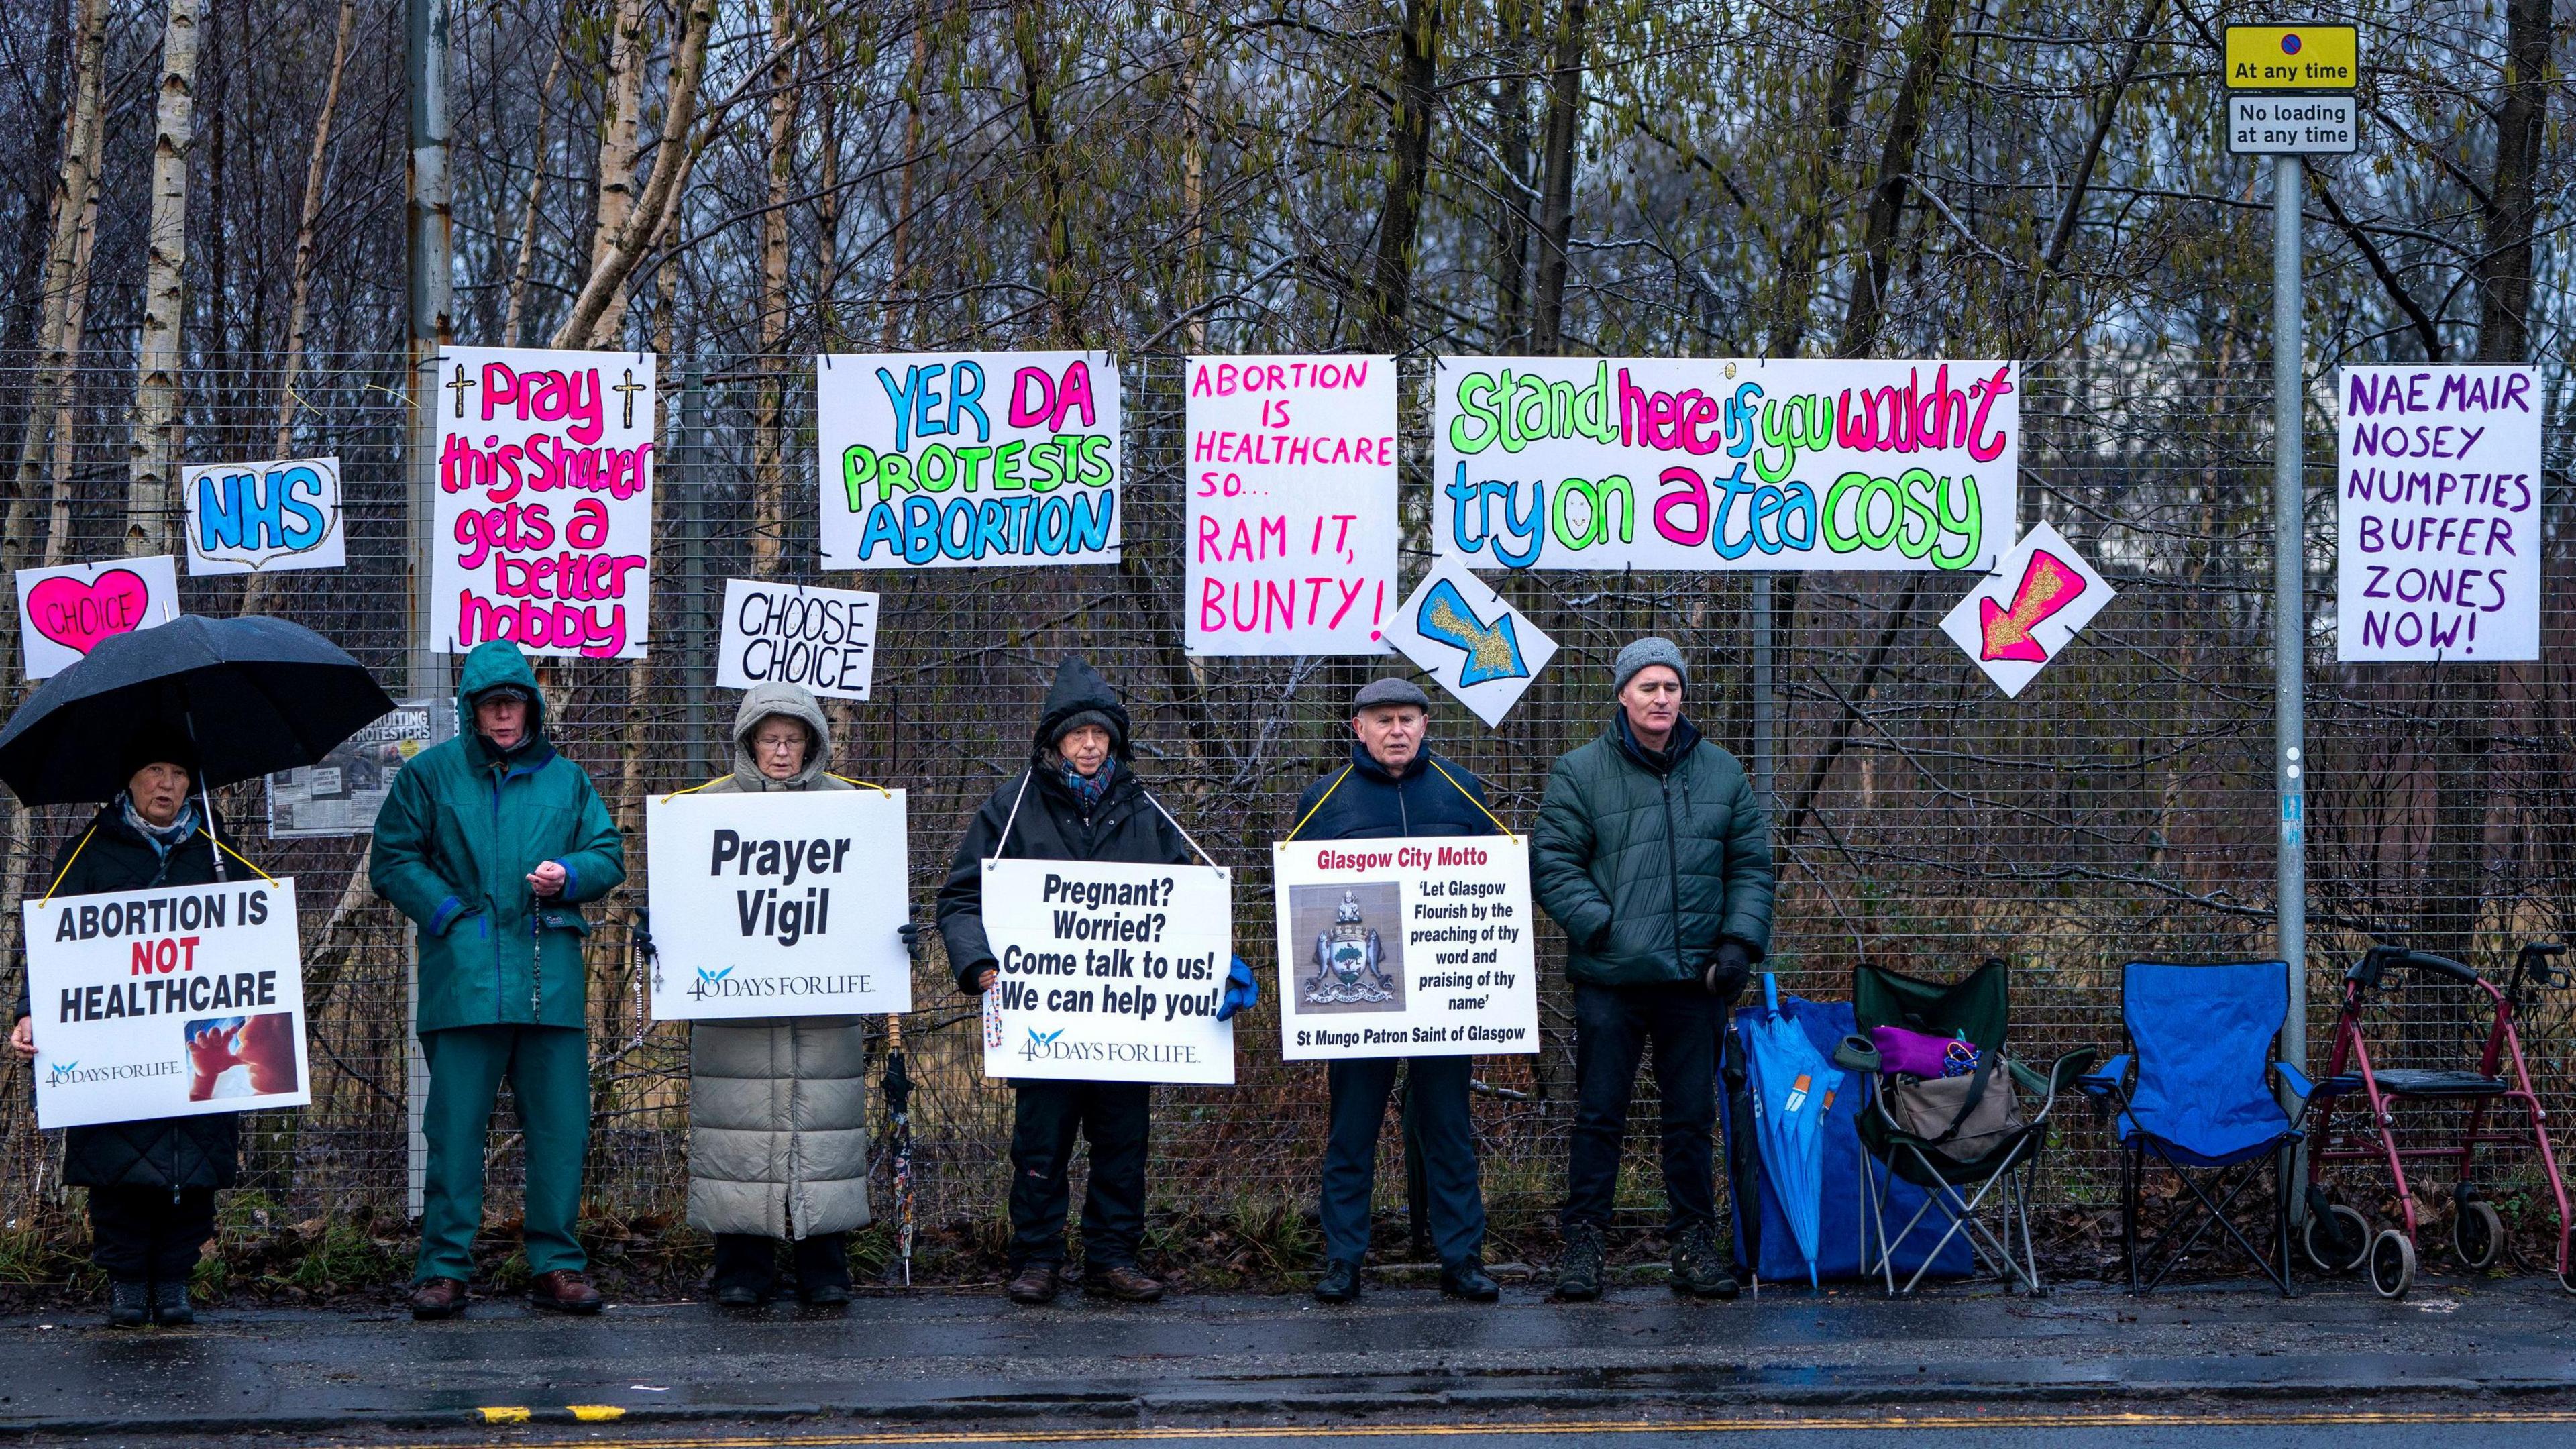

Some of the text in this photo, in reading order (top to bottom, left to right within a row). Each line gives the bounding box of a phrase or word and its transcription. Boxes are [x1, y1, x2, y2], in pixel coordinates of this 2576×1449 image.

[2235, 63, 2347, 81] At any time
[2240, 105, 2345, 123] No loading
[2238, 127, 2348, 146] at any time
[1193, 361, 1368, 398] ABORTION
[2347, 373, 2530, 416] NAE MAIR
[876, 360, 1095, 452] YER DA
[1262, 400, 1291, 428] IS
[1618, 368, 1720, 455] here
[1755, 394, 1834, 483] you
[1195, 431, 1394, 466] HEALTHCARE
[2352, 422, 2485, 460] NOSEY
[440, 433, 523, 503] this
[843, 435, 1114, 513] PROTESTS
[1197, 472, 1269, 497] SO...
[198, 467, 325, 551] NHS
[2347, 467, 2531, 512] NUMPTIES
[455, 498, 608, 570] gets a
[858, 489, 1114, 564] ABORTION
[1446, 461, 1984, 571] try on a tea cosy
[2359, 515, 2516, 557] BUFFER
[1199, 515, 1357, 564] RAM IT,
[496, 552, 646, 602] better
[2363, 565, 2508, 612] ZONES
[46, 591, 133, 635] CHOICE
[459, 588, 625, 658] hobby
[739, 592, 869, 647] CHOOSE
[2363, 610, 2476, 654] NOW!
[743, 639, 863, 690] CHOICE
[711, 829, 850, 886] Prayer
[1317, 847, 1487, 872] Glasgow City Motto
[1043, 873, 1174, 910] Pregnant?
[1448, 880, 1505, 898] Glasgow
[56, 890, 268, 943] ABORTION IS
[737, 888, 829, 947] Vigil
[1054, 911, 1166, 942] Worried?
[1414, 902, 1513, 920] Flourish by the
[131, 936, 199, 976] NOT
[1411, 926, 1519, 945] preaching of thy
[1004, 945, 1214, 980] Come talk to us!
[1436, 949, 1497, 964] word and
[60, 970, 277, 1024] HEALTHCARE
[687, 977, 720, 1002] 40
[723, 977, 775, 997] DAYS
[780, 976, 827, 995] FOR
[1001, 981, 1218, 1022] We can help you!
[1419, 971, 1515, 991] praising of thy
[1018, 1038, 1051, 1061] 40
[1053, 1042, 1103, 1060] DAYS
[1108, 1043, 1154, 1062] FOR
[1297, 1026, 1525, 1047] St Mungo Patron Saint of Glasgow
[45, 1070, 69, 1087] 40
[72, 1067, 109, 1083] DAYS
[112, 1065, 148, 1079] FOR
